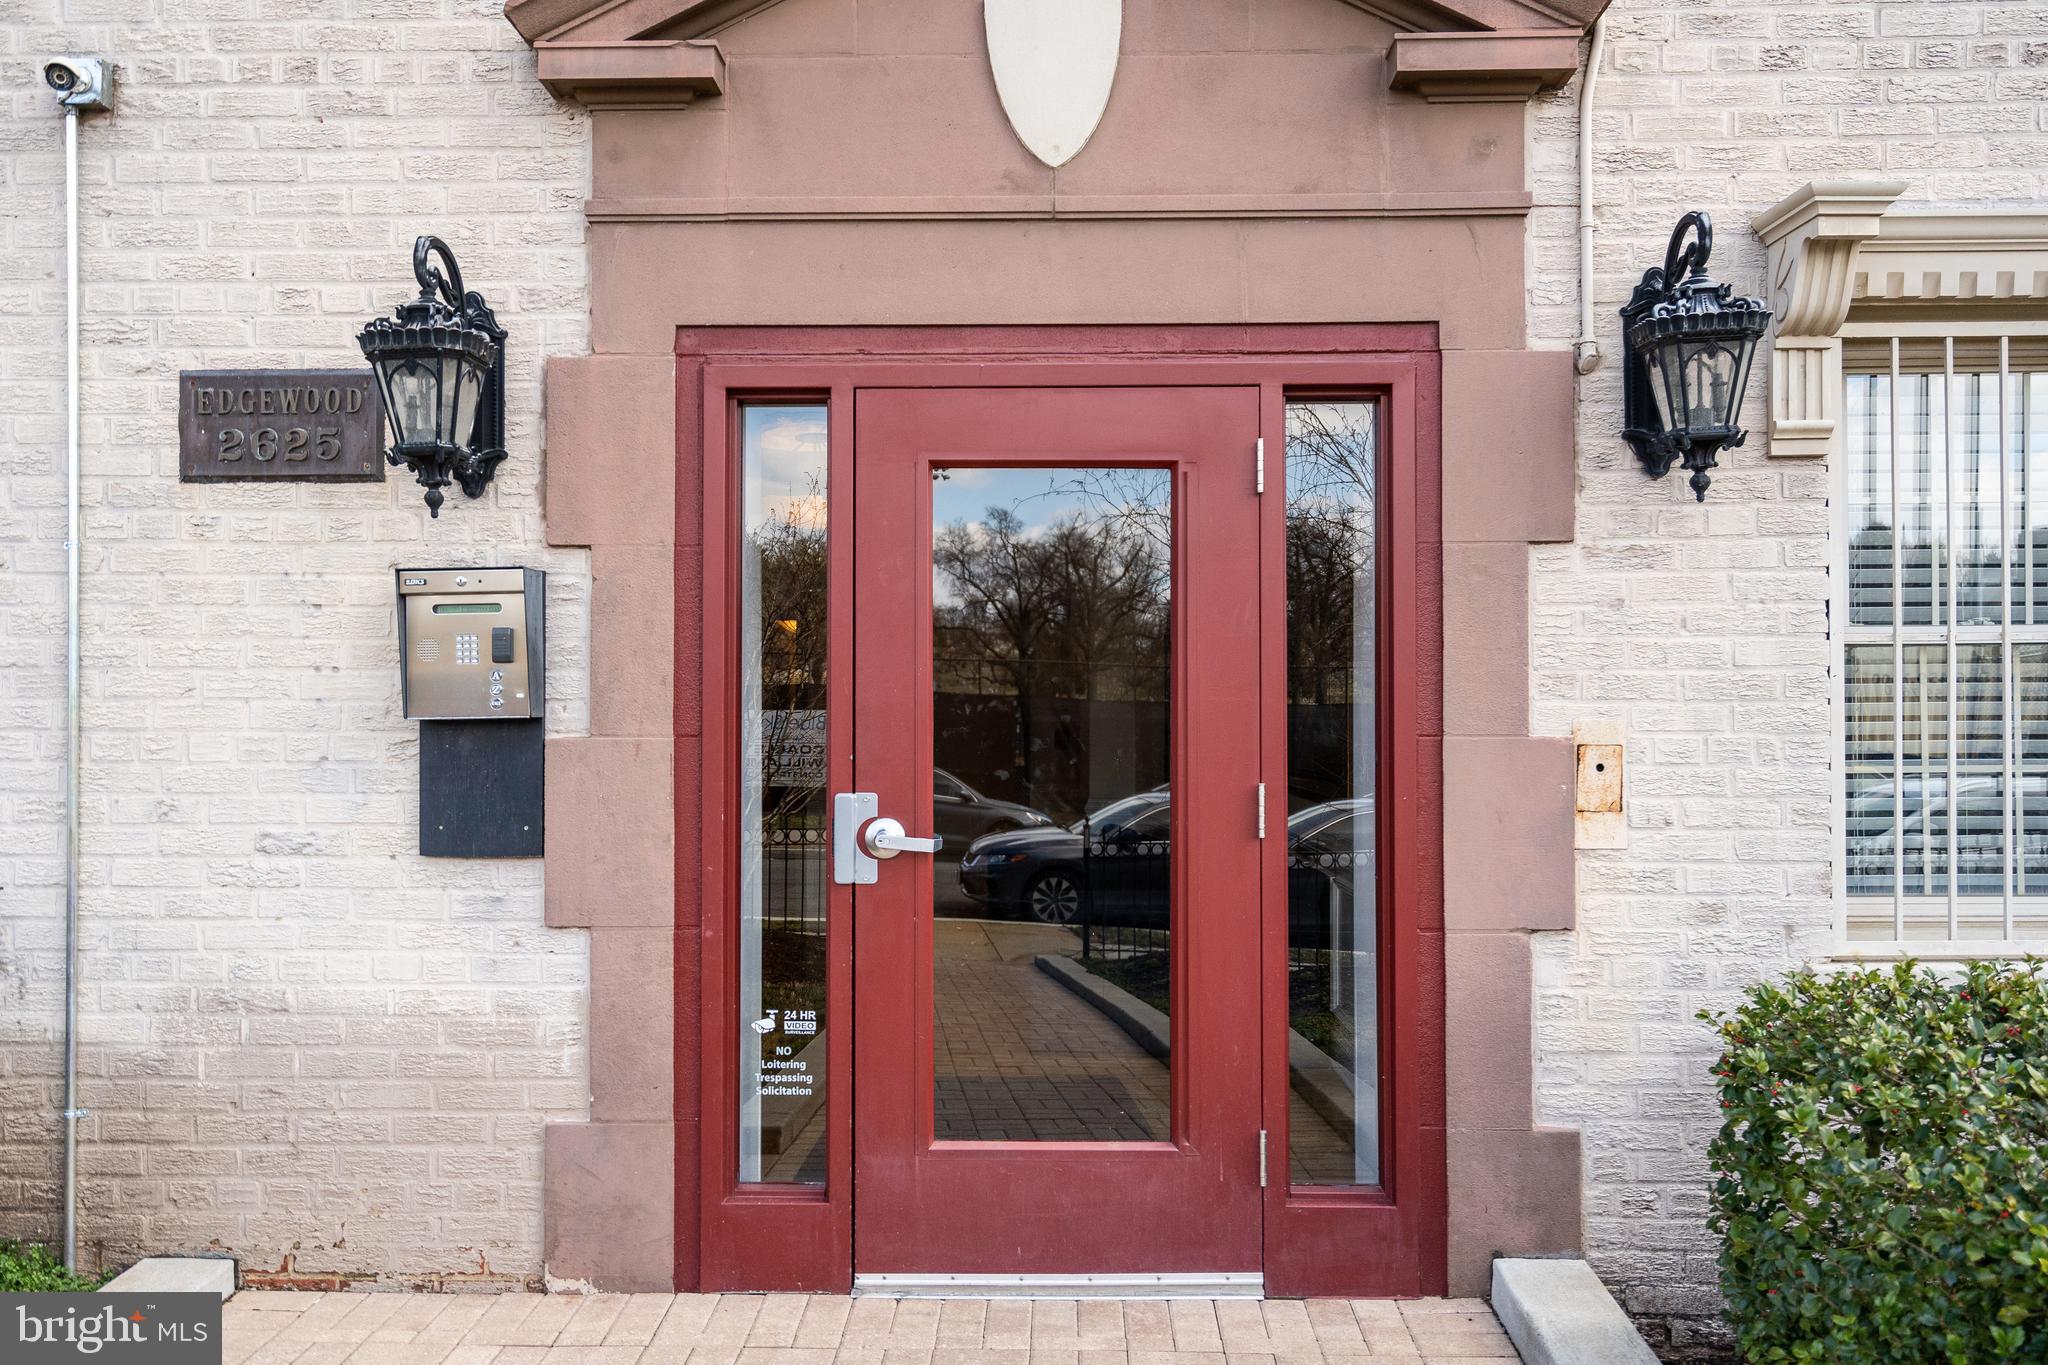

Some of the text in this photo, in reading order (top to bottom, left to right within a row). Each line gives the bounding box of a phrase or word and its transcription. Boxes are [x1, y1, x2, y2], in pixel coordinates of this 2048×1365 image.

[197, 387, 363, 414] EDGEWOOD
[218, 427, 342, 462] 2625
[784, 1010, 816, 1020] 24 HR
[776, 1046, 792, 1056] NO
[761, 1060, 806, 1071] Loitering
[755, 1073, 813, 1084] Trespassing
[756, 1086, 812, 1096] Solicitation
